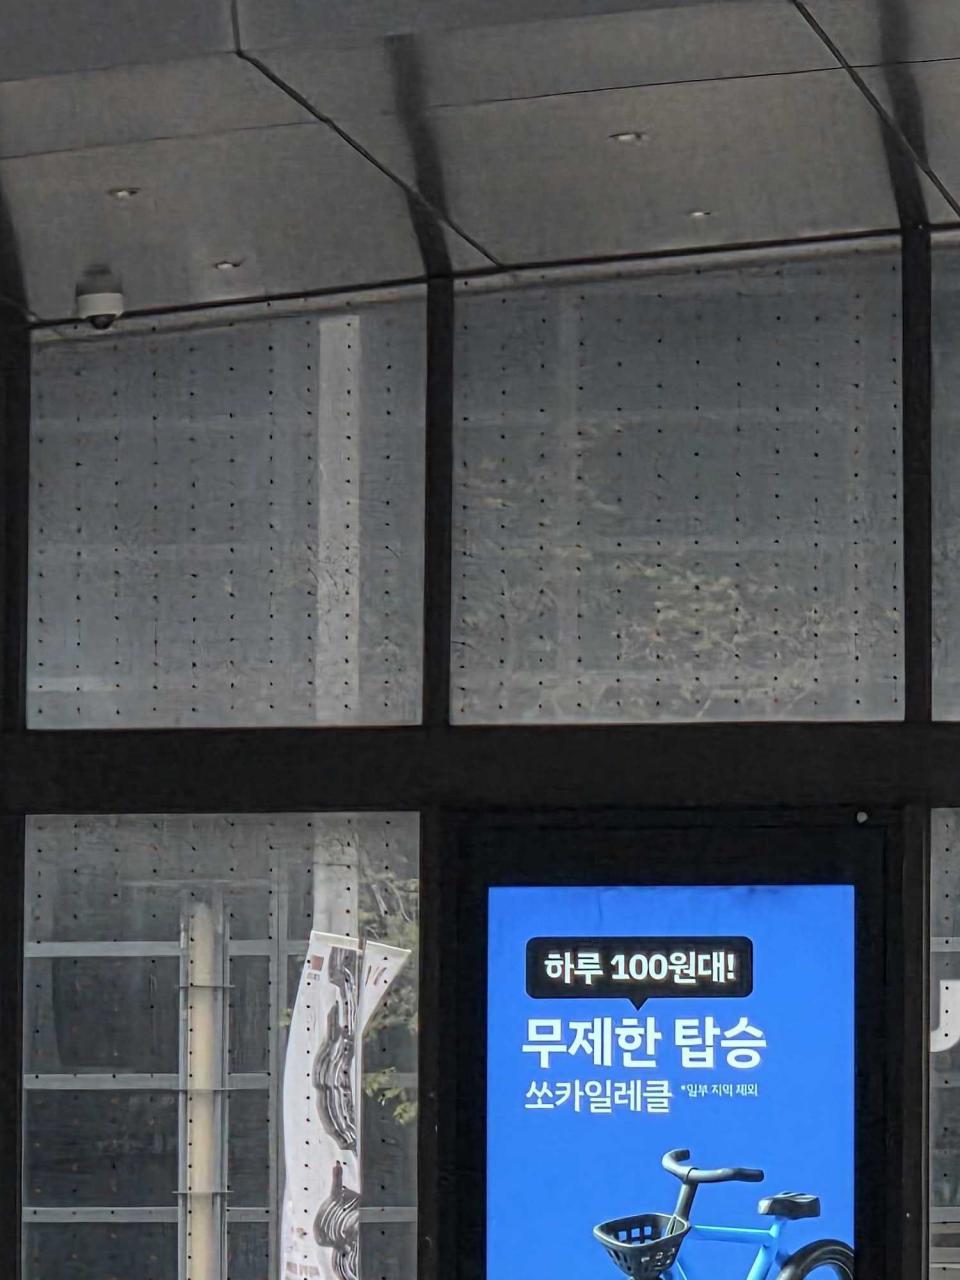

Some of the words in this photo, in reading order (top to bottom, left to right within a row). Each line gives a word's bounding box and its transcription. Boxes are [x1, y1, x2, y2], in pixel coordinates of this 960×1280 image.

[544, 951, 603, 985] 하루
[610, 951, 736, 984] 100원대!
[522, 1016, 662, 1069] 무제한
[674, 1016, 767, 1069] 탑승
[524, 1080, 673, 1113] 쏘카일레클
